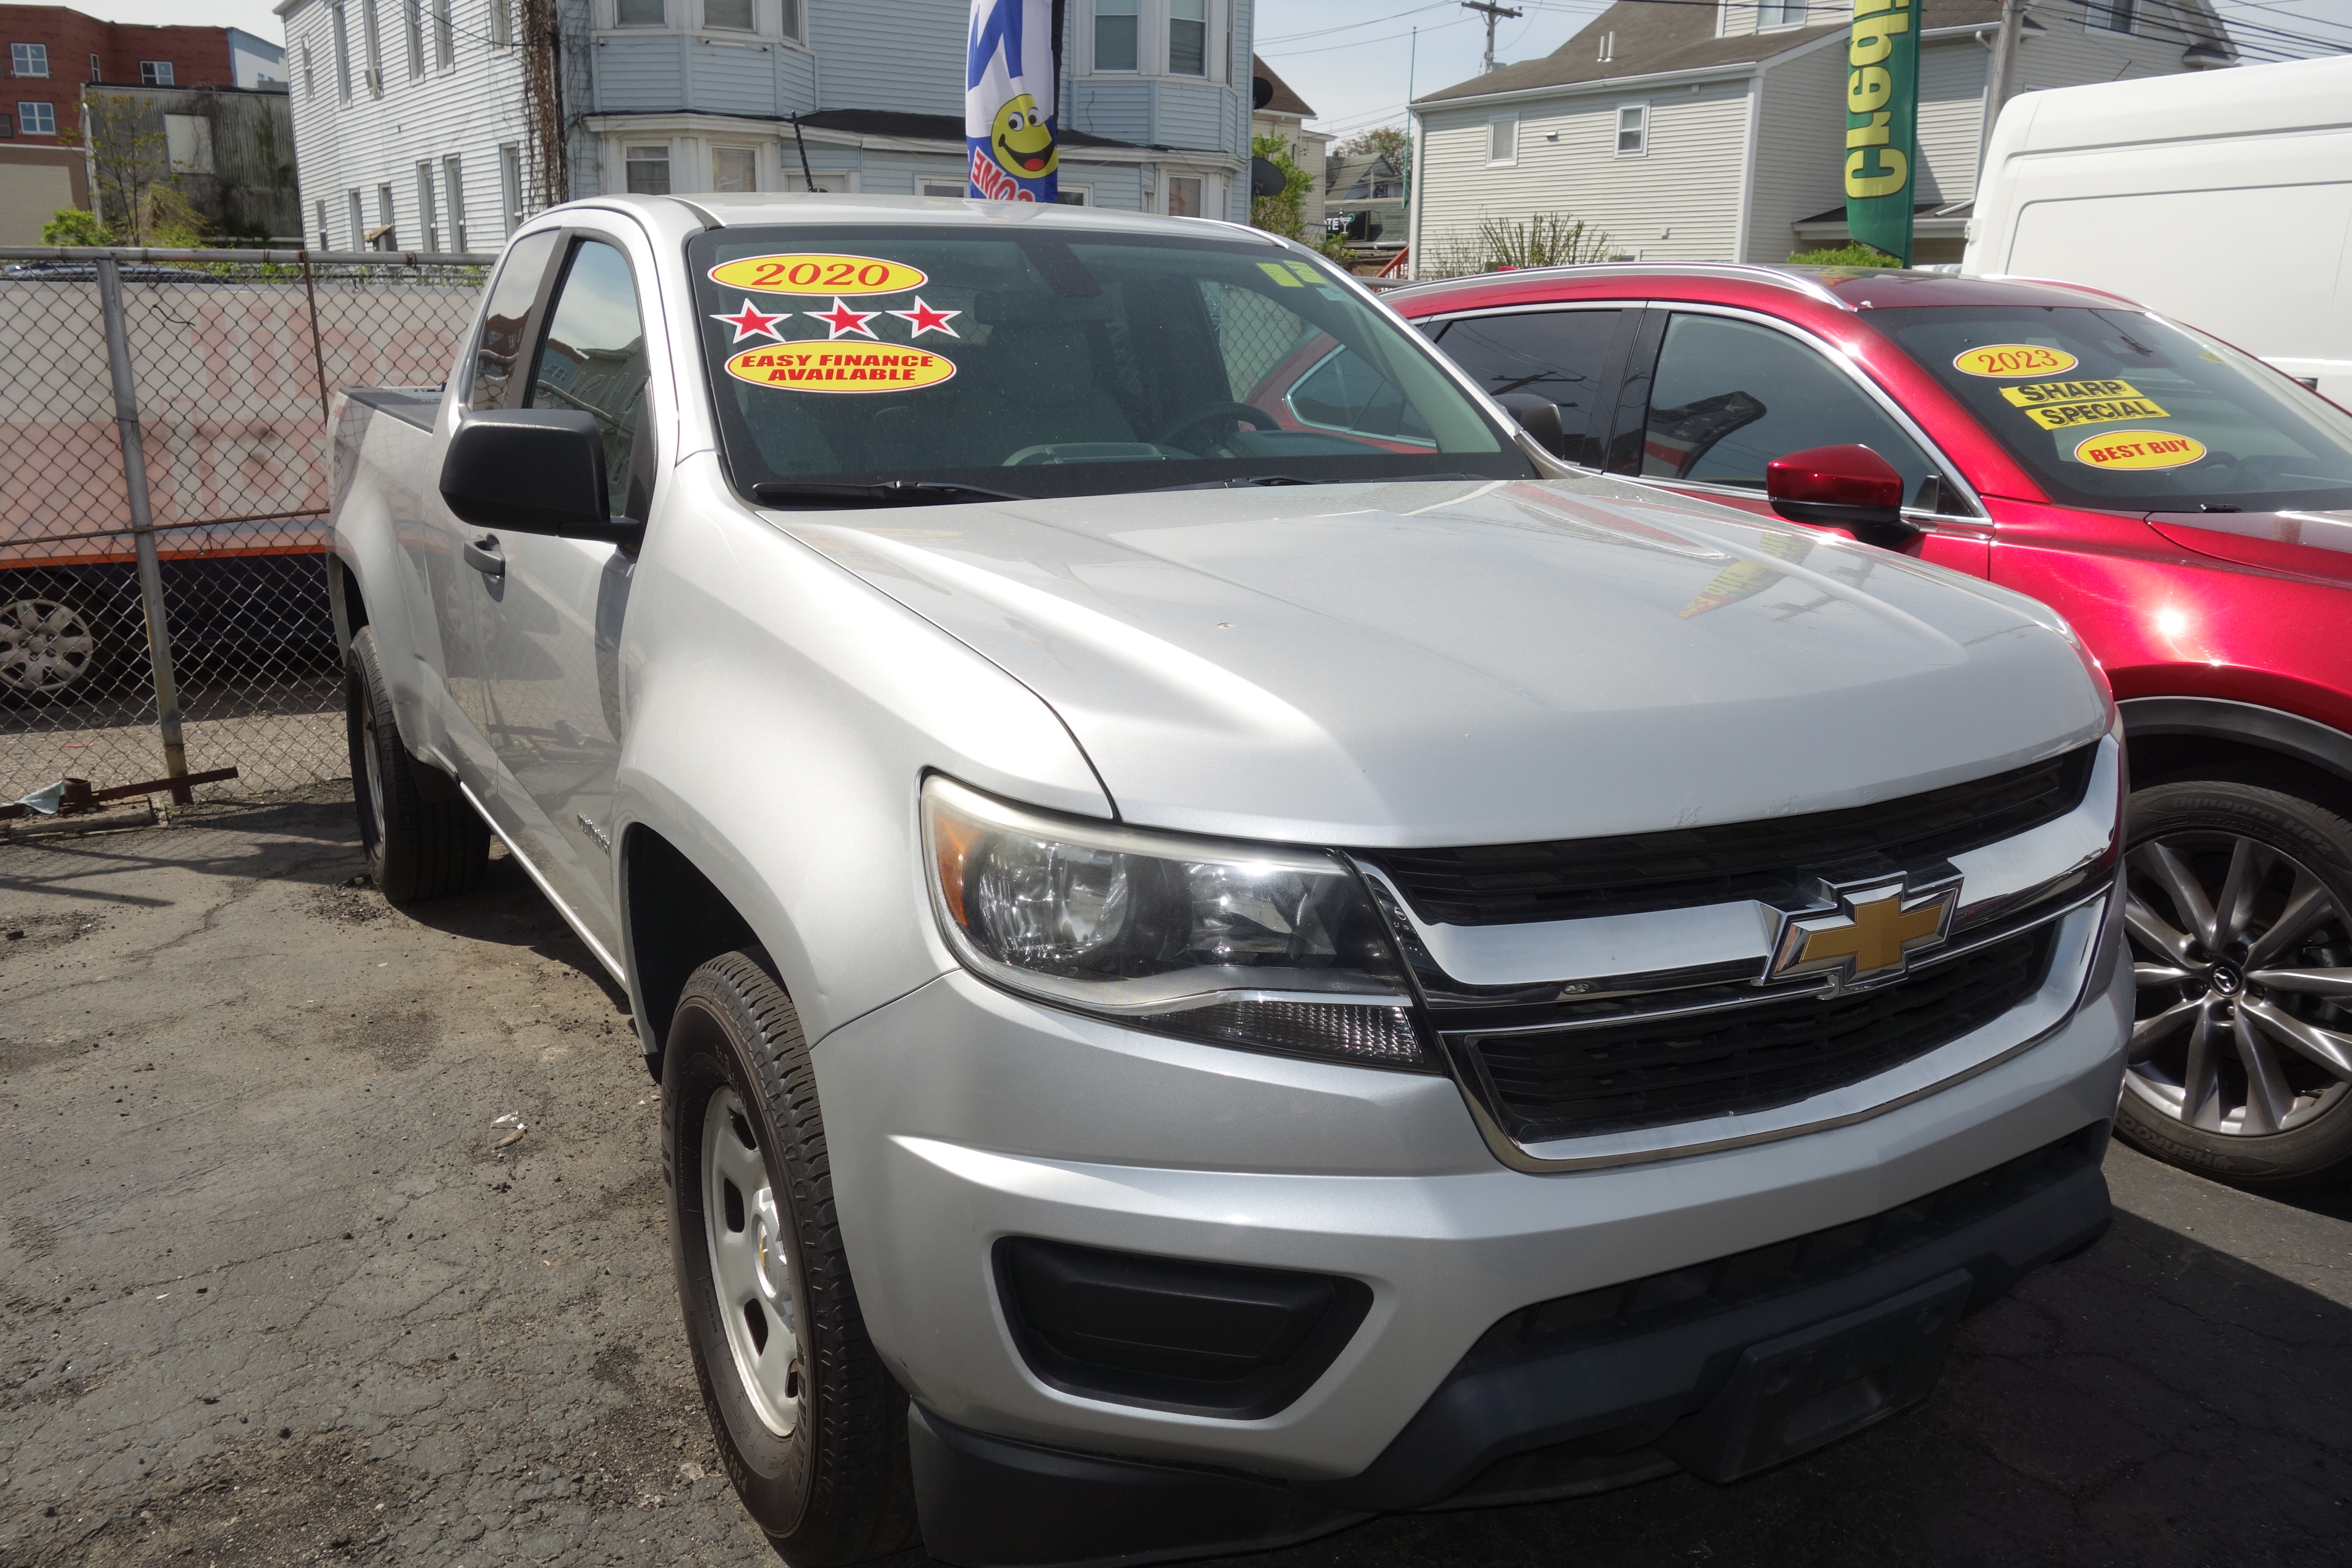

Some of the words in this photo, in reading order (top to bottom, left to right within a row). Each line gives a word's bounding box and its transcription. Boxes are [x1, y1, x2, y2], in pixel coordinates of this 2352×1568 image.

[751, 263, 890, 287] 2020
[741, 354, 812, 368] EASY
[818, 354, 934, 367] FINANCE
[1978, 350, 2058, 374] 2023
[767, 368, 916, 381] AVAILABLE
[2018, 380, 2125, 401] SHARP
[2040, 401, 2160, 426] SPECIAL
[2088, 443, 2145, 463] BEST
[2147, 439, 2191, 454] BUY
[2171, 796, 2277, 823] Dynapro
[2282, 819, 2336, 856] HP2
[2116, 1110, 2214, 1167] Hankoo
